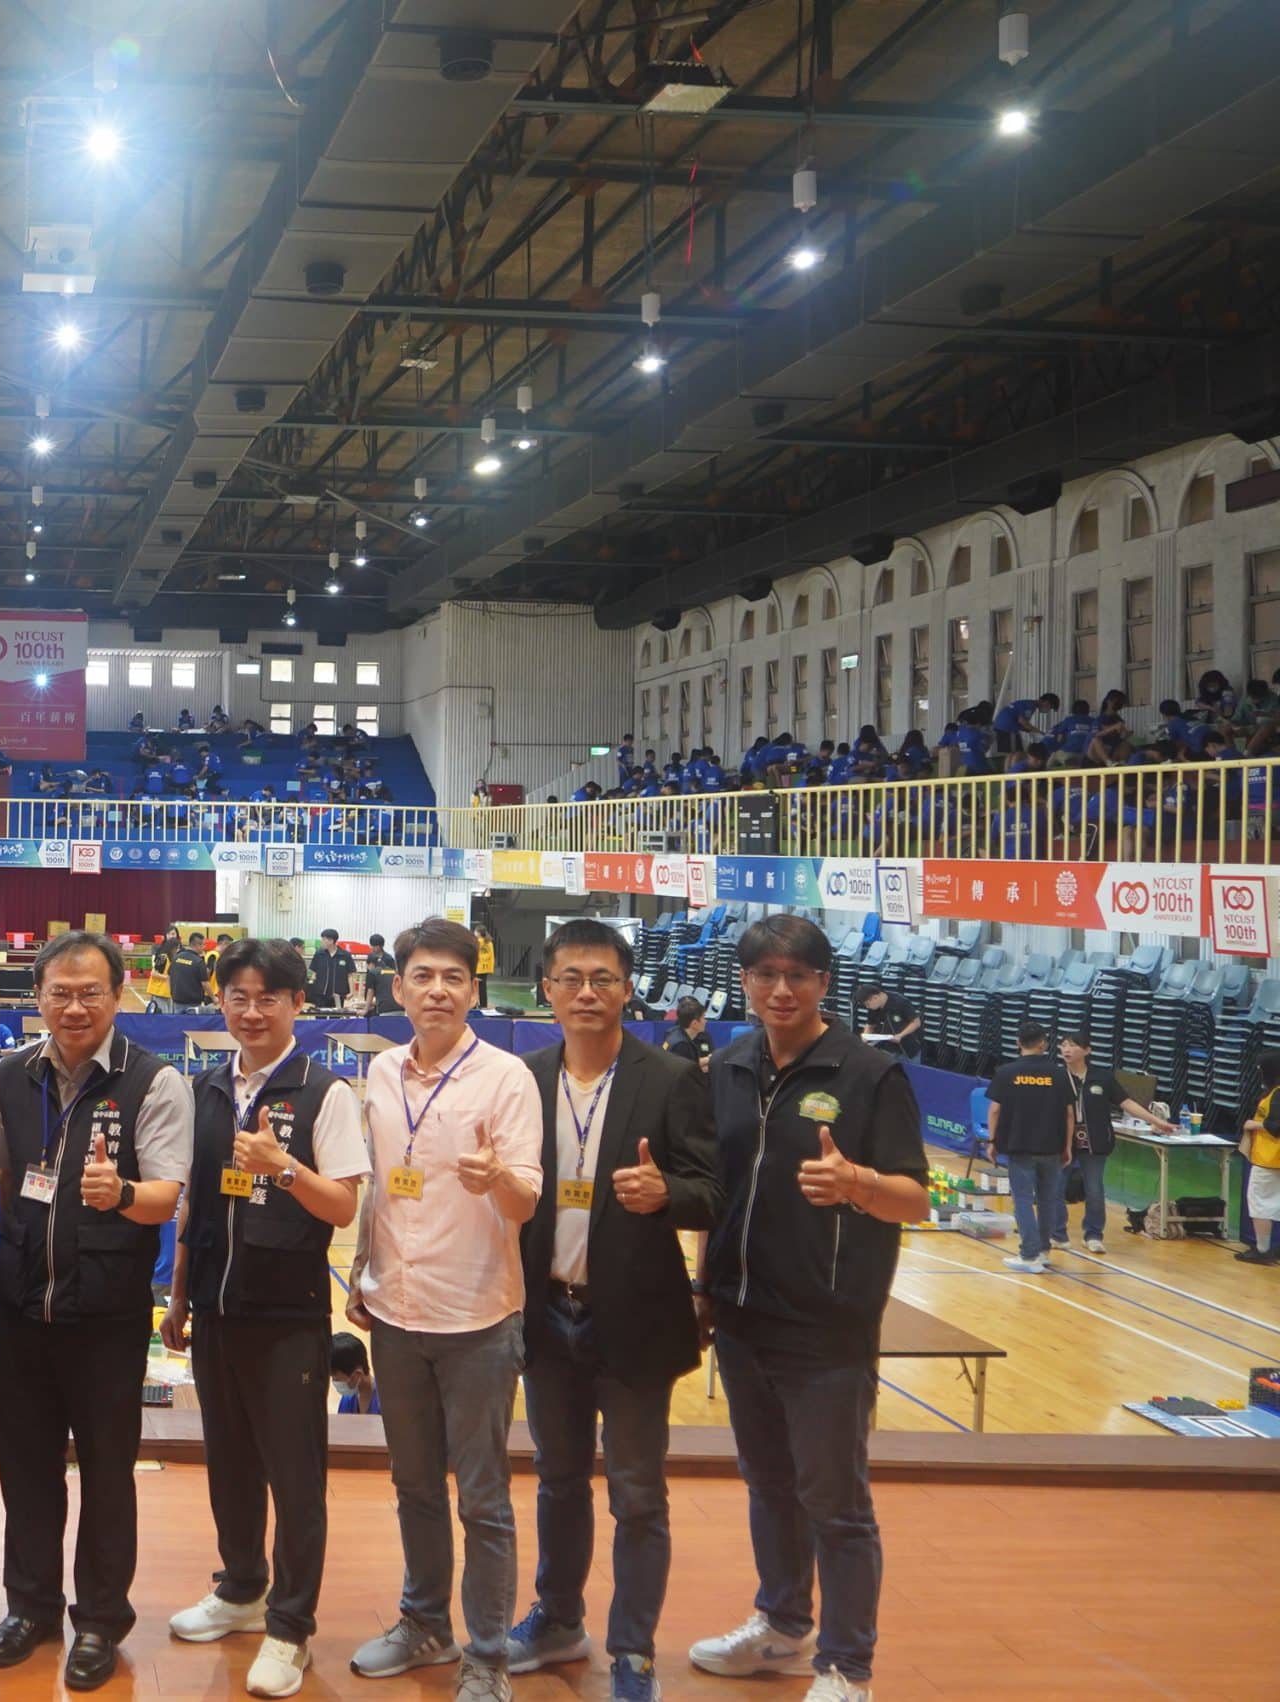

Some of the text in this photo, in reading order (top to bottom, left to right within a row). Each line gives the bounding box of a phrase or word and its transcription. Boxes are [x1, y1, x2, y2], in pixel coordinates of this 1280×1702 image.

[14, 631, 65, 642] NTCUST
[14, 642, 65, 660] 100th
[849, 879, 872, 894] 100th
[1152, 878, 1194, 890] NTCUST
[1152, 892, 1193, 913] 100th
[1224, 914, 1255, 924] NTCUST
[1224, 925, 1256, 939] 100th
[1014, 1075, 1053, 1086] JUDGE
